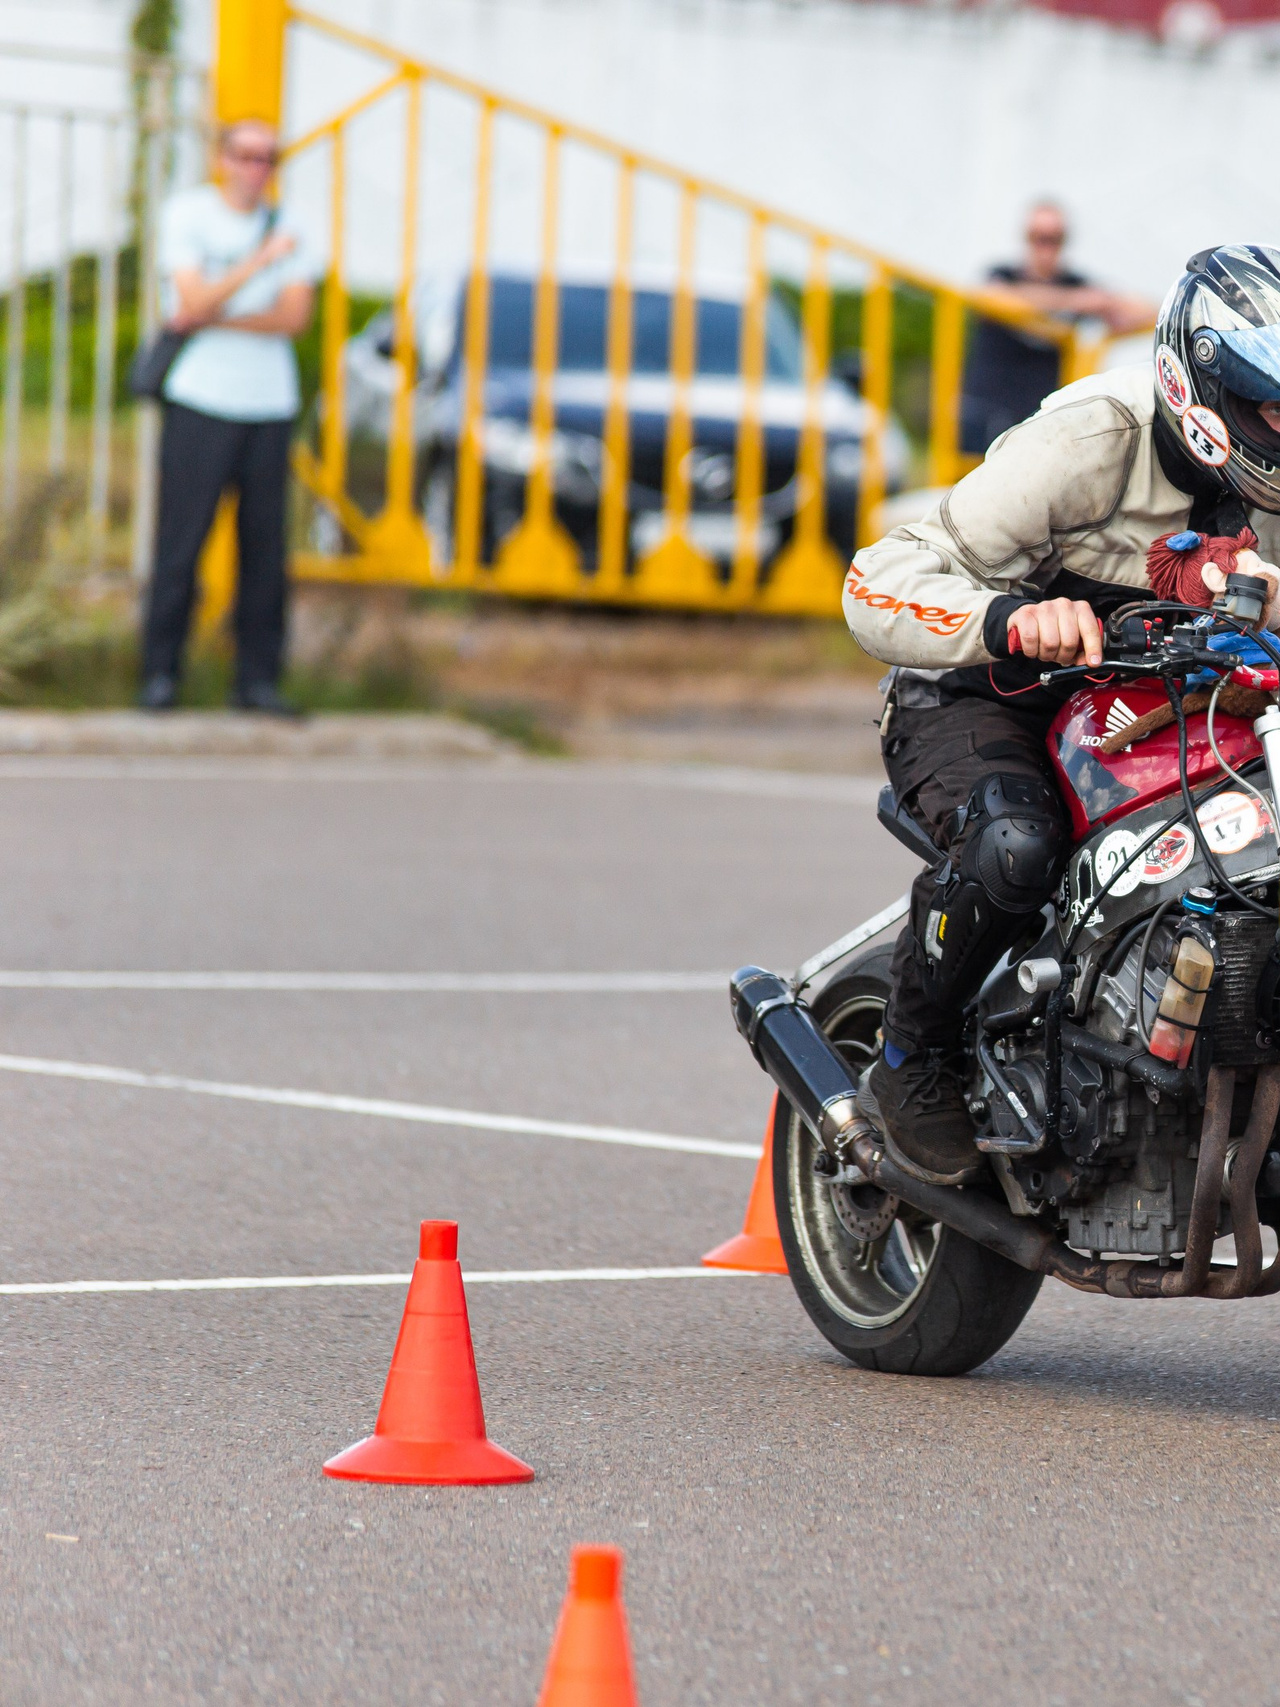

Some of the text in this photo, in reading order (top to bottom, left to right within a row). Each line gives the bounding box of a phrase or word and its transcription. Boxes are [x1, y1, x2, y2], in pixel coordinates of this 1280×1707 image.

[1190, 428, 1215, 457] 13
[1079, 735, 1132, 753] HOA
[1214, 815, 1242, 842] 17
